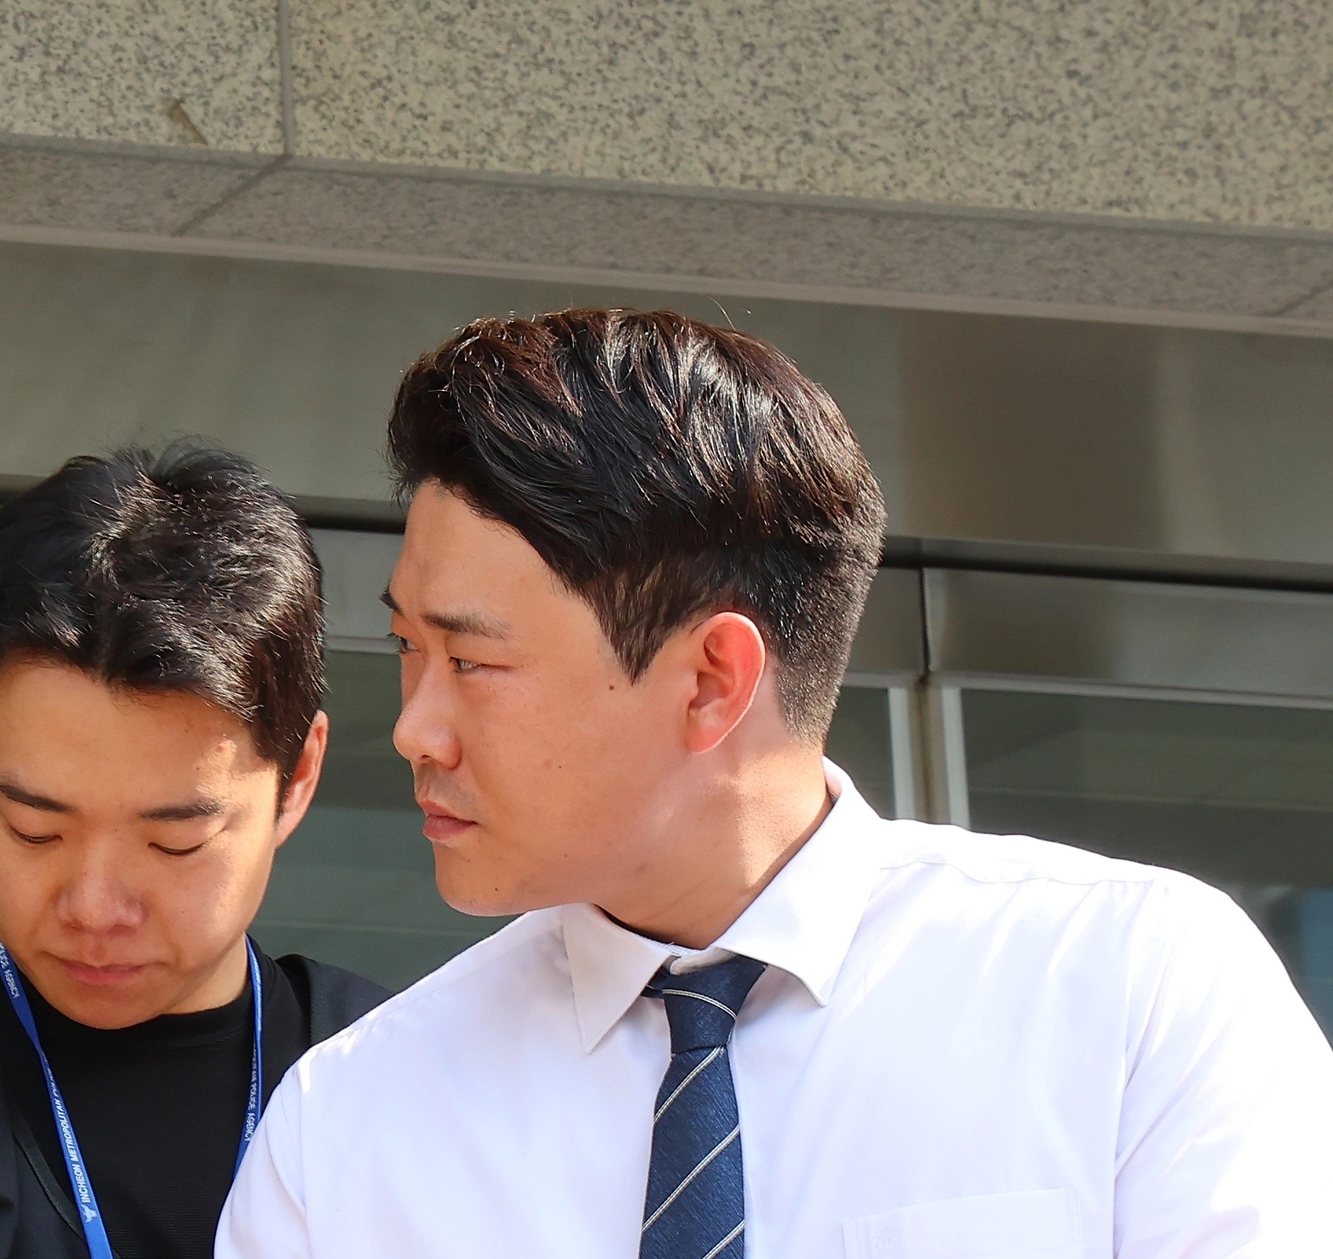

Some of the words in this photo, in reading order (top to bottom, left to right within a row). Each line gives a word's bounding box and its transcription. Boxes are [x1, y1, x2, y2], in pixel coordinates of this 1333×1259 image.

[4, 969, 20, 998] AGENCY
[53, 1098, 79, 1162] METROPOLITAN
[244, 1112, 256, 1142] AGENCY
[73, 1163, 91, 1203] INCHEON
